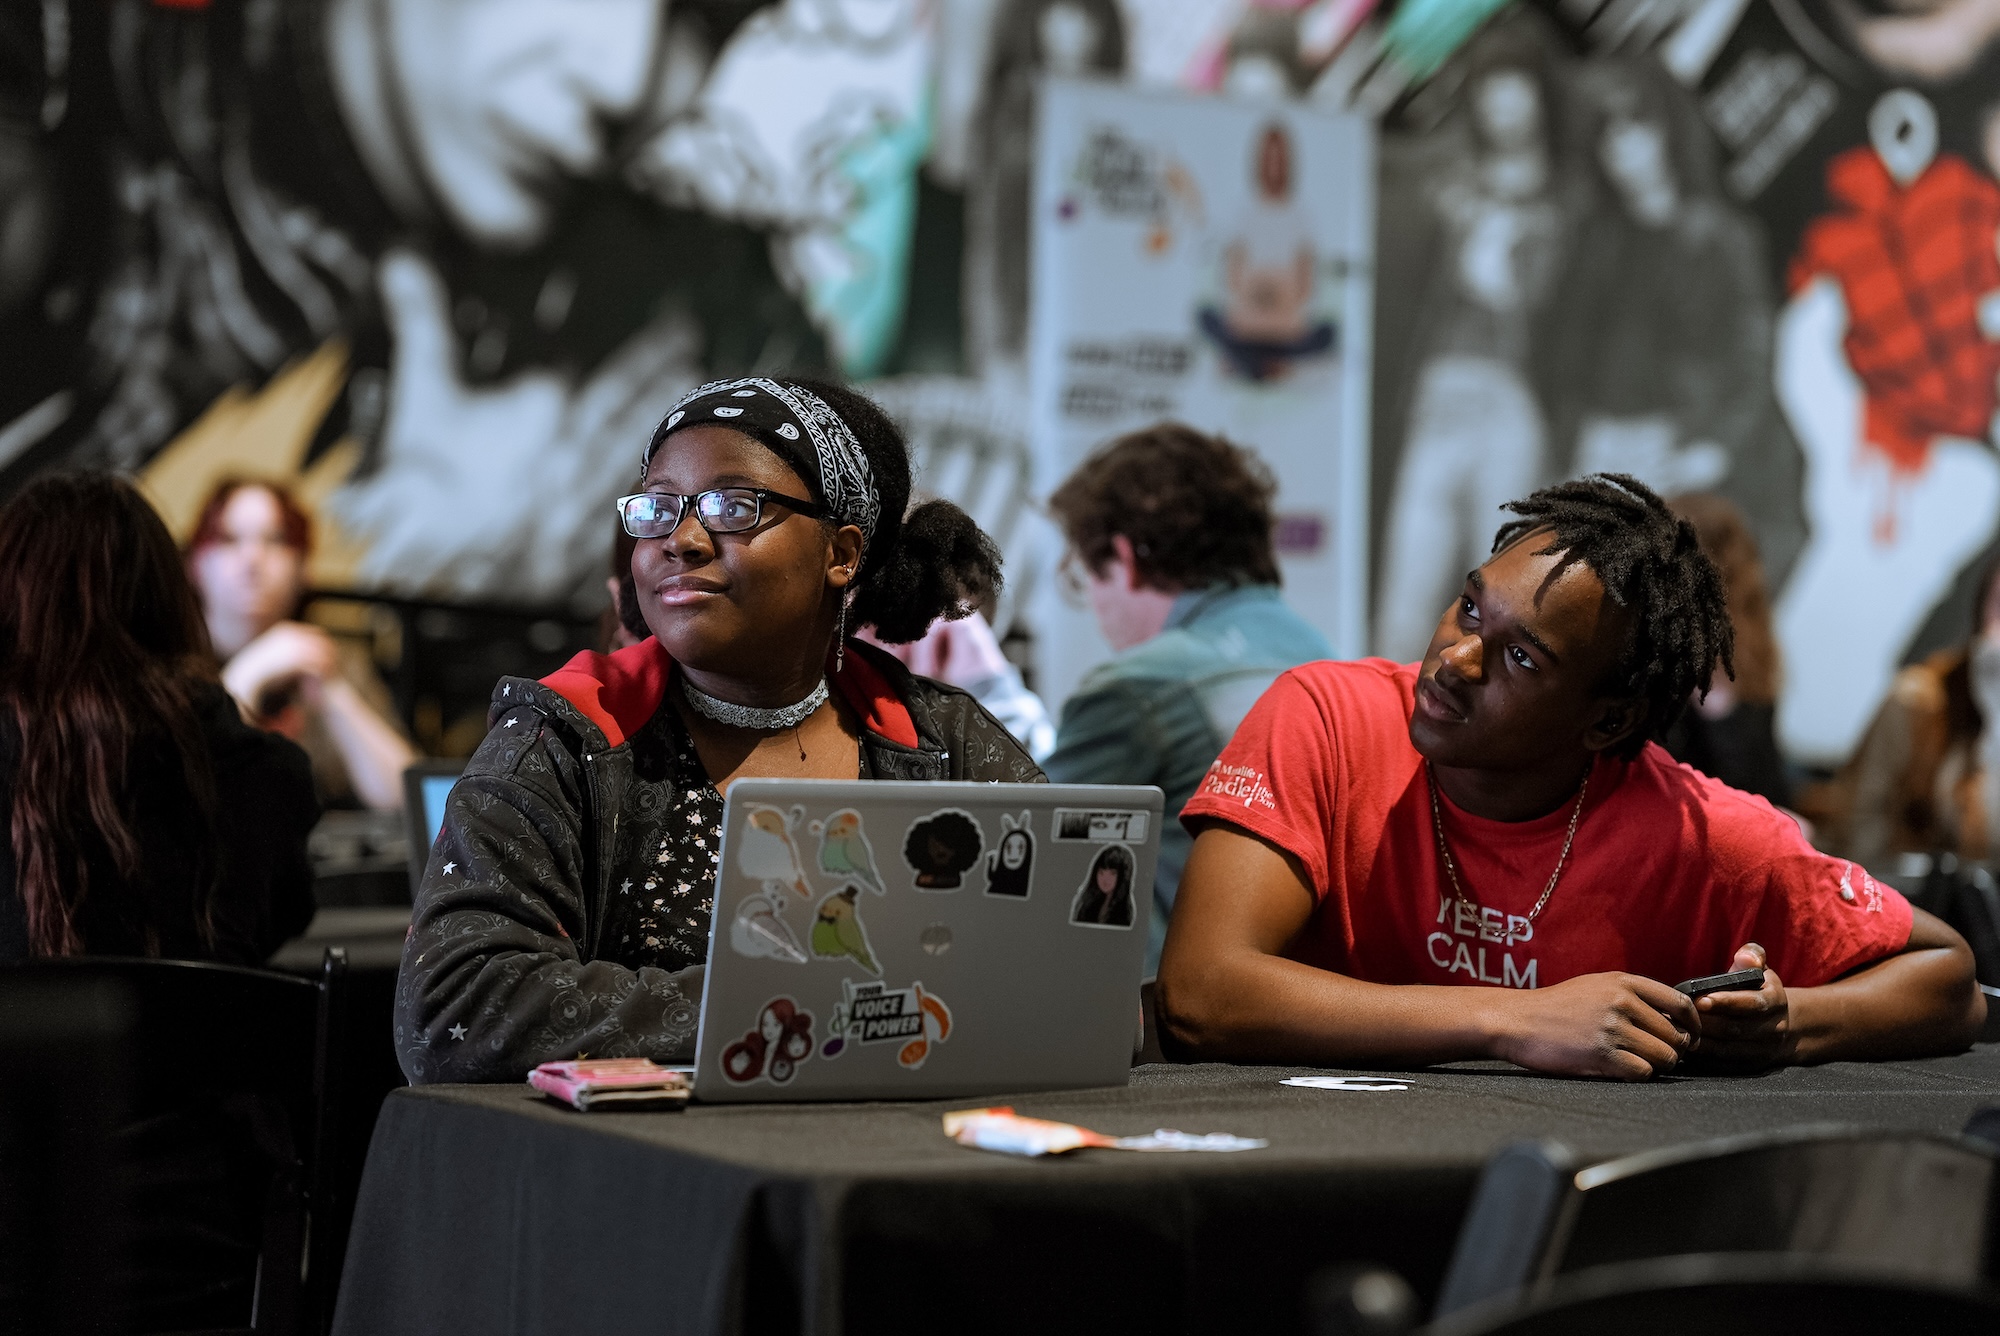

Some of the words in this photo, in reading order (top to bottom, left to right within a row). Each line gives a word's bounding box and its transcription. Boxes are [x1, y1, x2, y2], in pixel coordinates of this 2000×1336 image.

[1257, 786, 1273, 799] the
[1427, 931, 1538, 989] CALM
[856, 985, 882, 997] YOUR
[855, 997, 899, 1018] VOICE
[866, 1016, 919, 1038] POWER
